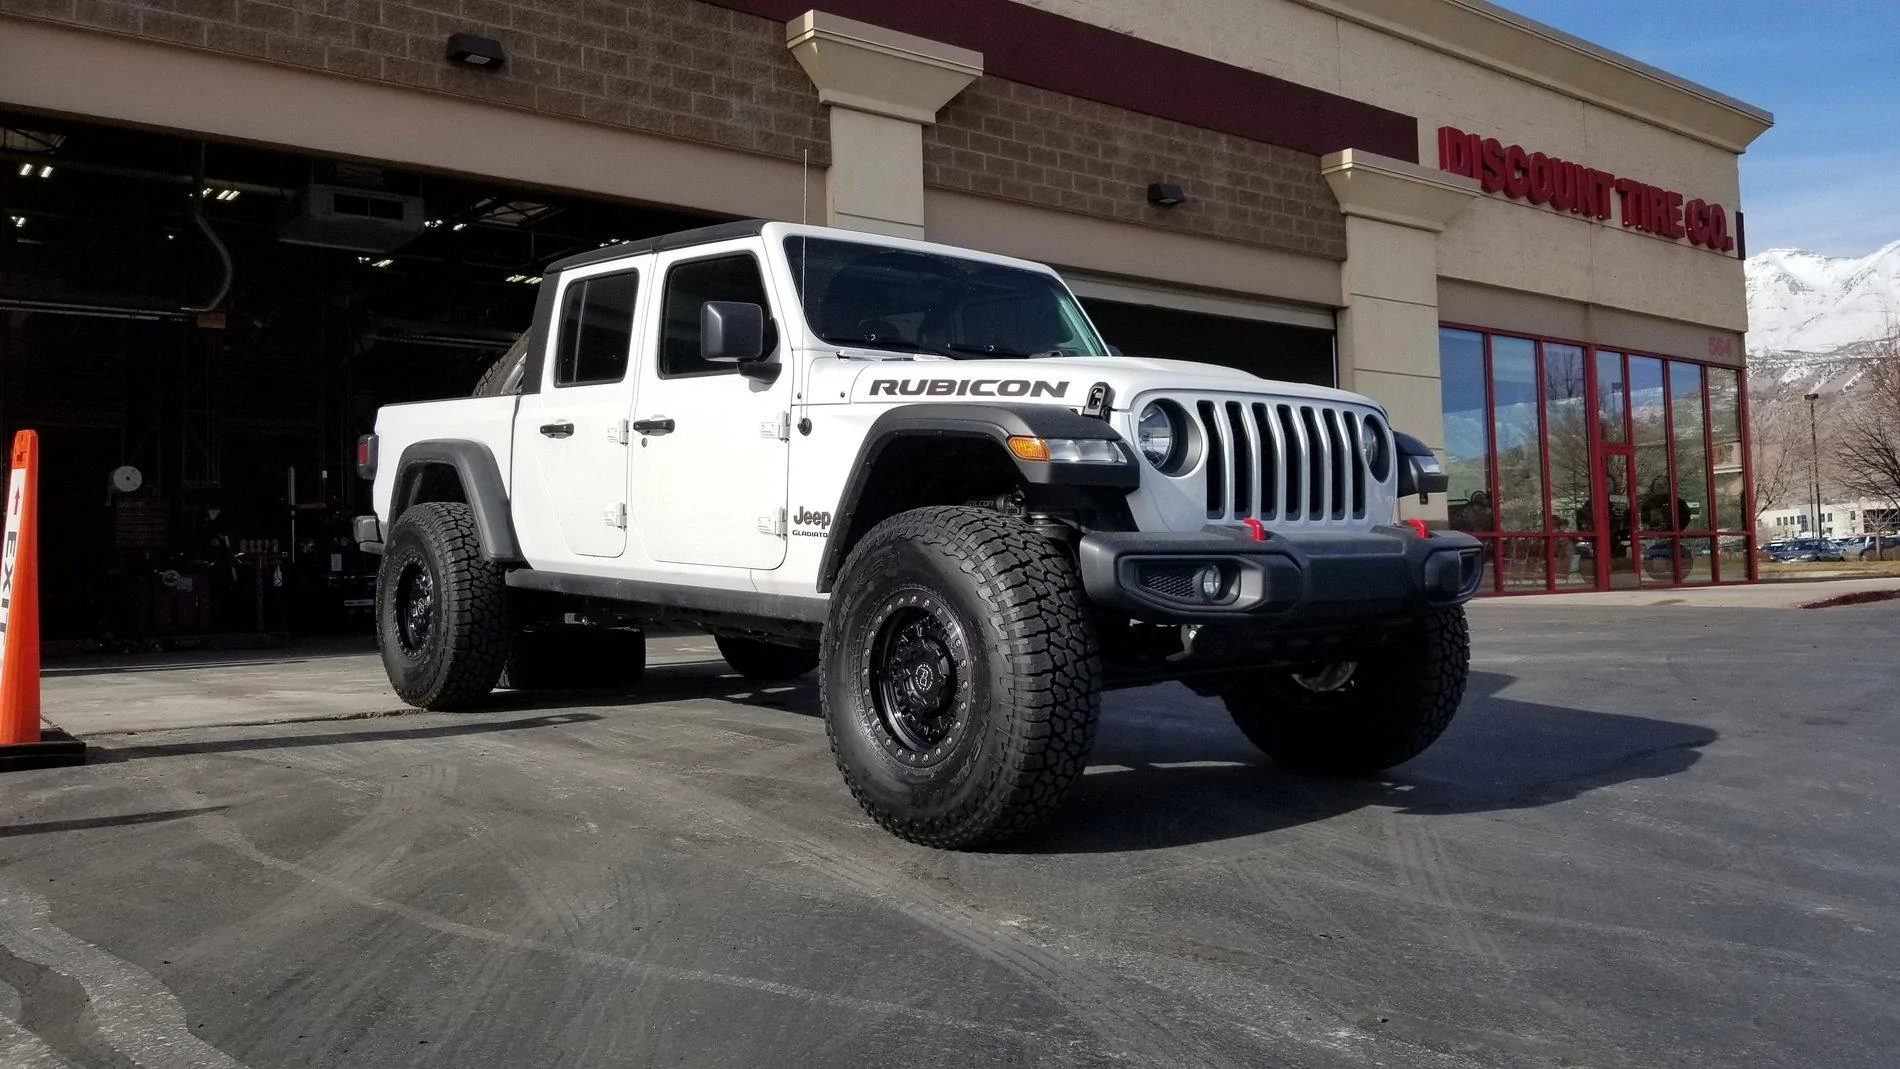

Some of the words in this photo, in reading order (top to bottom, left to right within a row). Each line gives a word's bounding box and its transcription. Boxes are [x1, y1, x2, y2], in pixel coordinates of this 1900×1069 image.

[1438, 126, 1614, 220] DISCOUNT
[1615, 177, 1685, 240] TIRE
[1685, 198, 1734, 251] CO.
[1708, 335, 1733, 358] 564
[869, 379, 1070, 398] RUBICON
[793, 505, 831, 530] Jeep
[792, 529, 828, 538] GLADIATO
